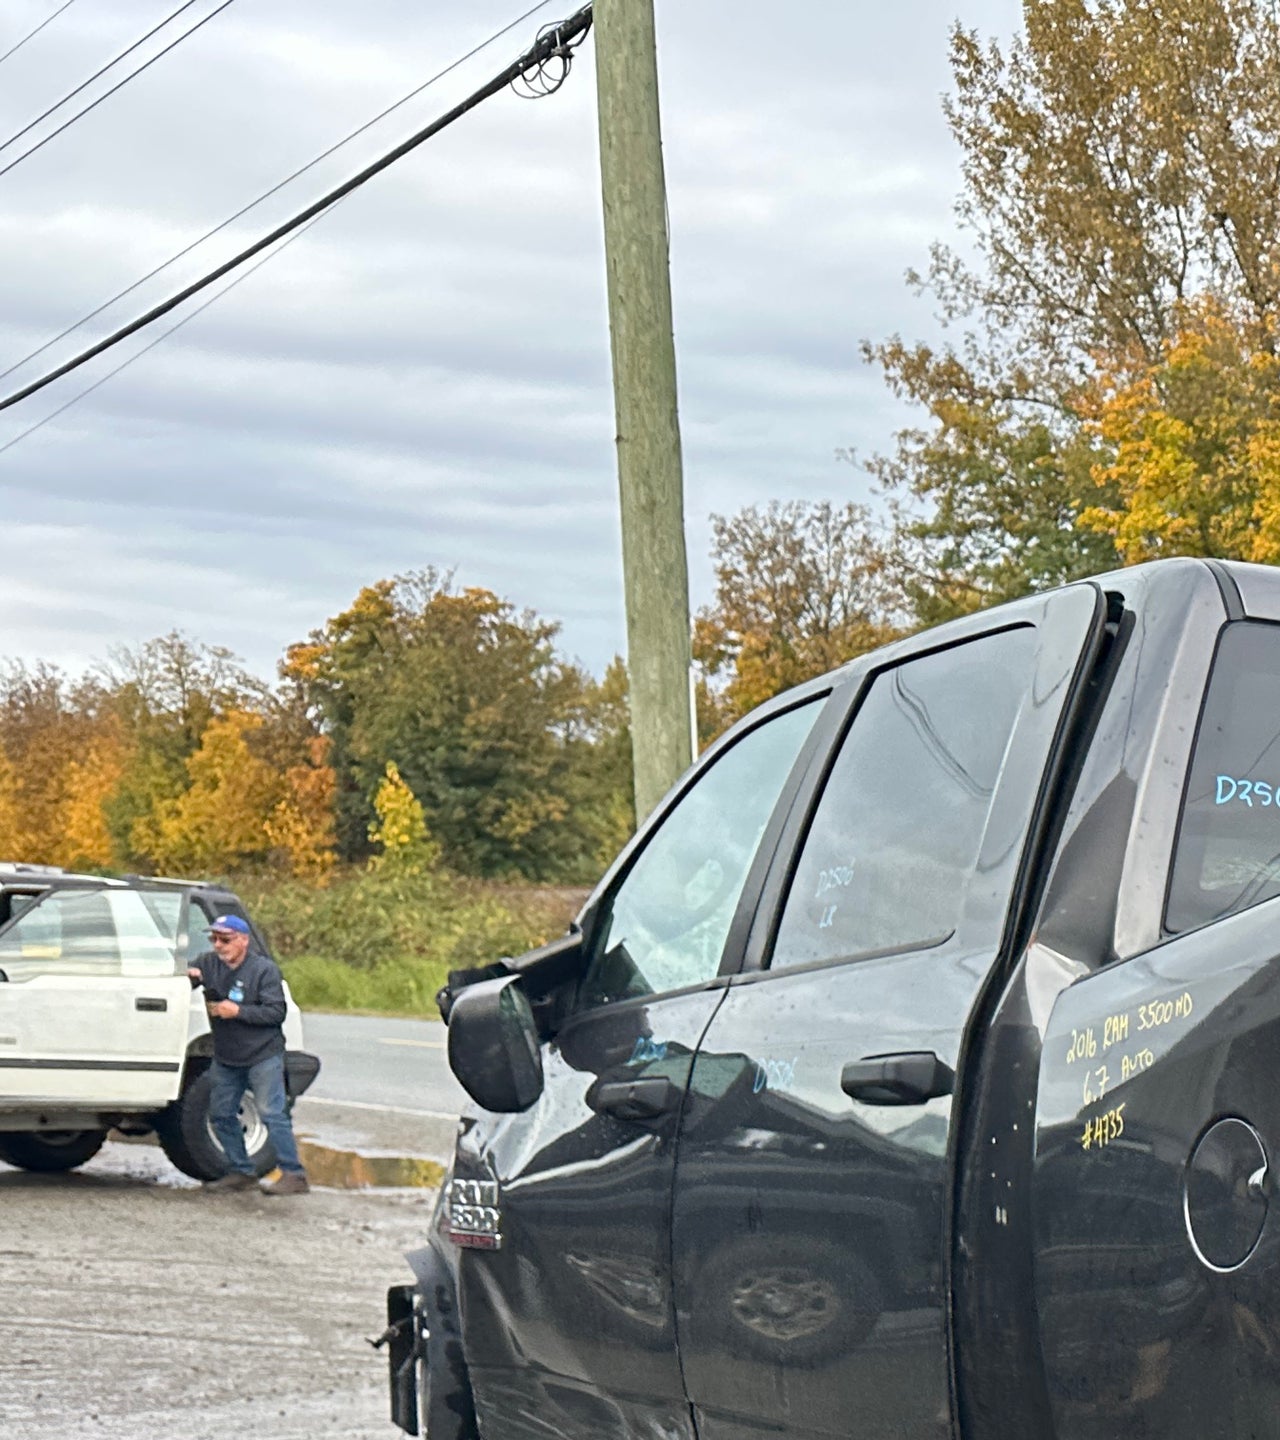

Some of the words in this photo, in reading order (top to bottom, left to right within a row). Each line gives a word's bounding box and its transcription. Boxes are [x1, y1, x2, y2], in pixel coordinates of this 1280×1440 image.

[1066, 1028, 1097, 1064] 2016
[1103, 1013, 1129, 1050] RAM
[1083, 1065, 1110, 1105] 6.7
[1121, 1048, 1154, 1081] AUTO
